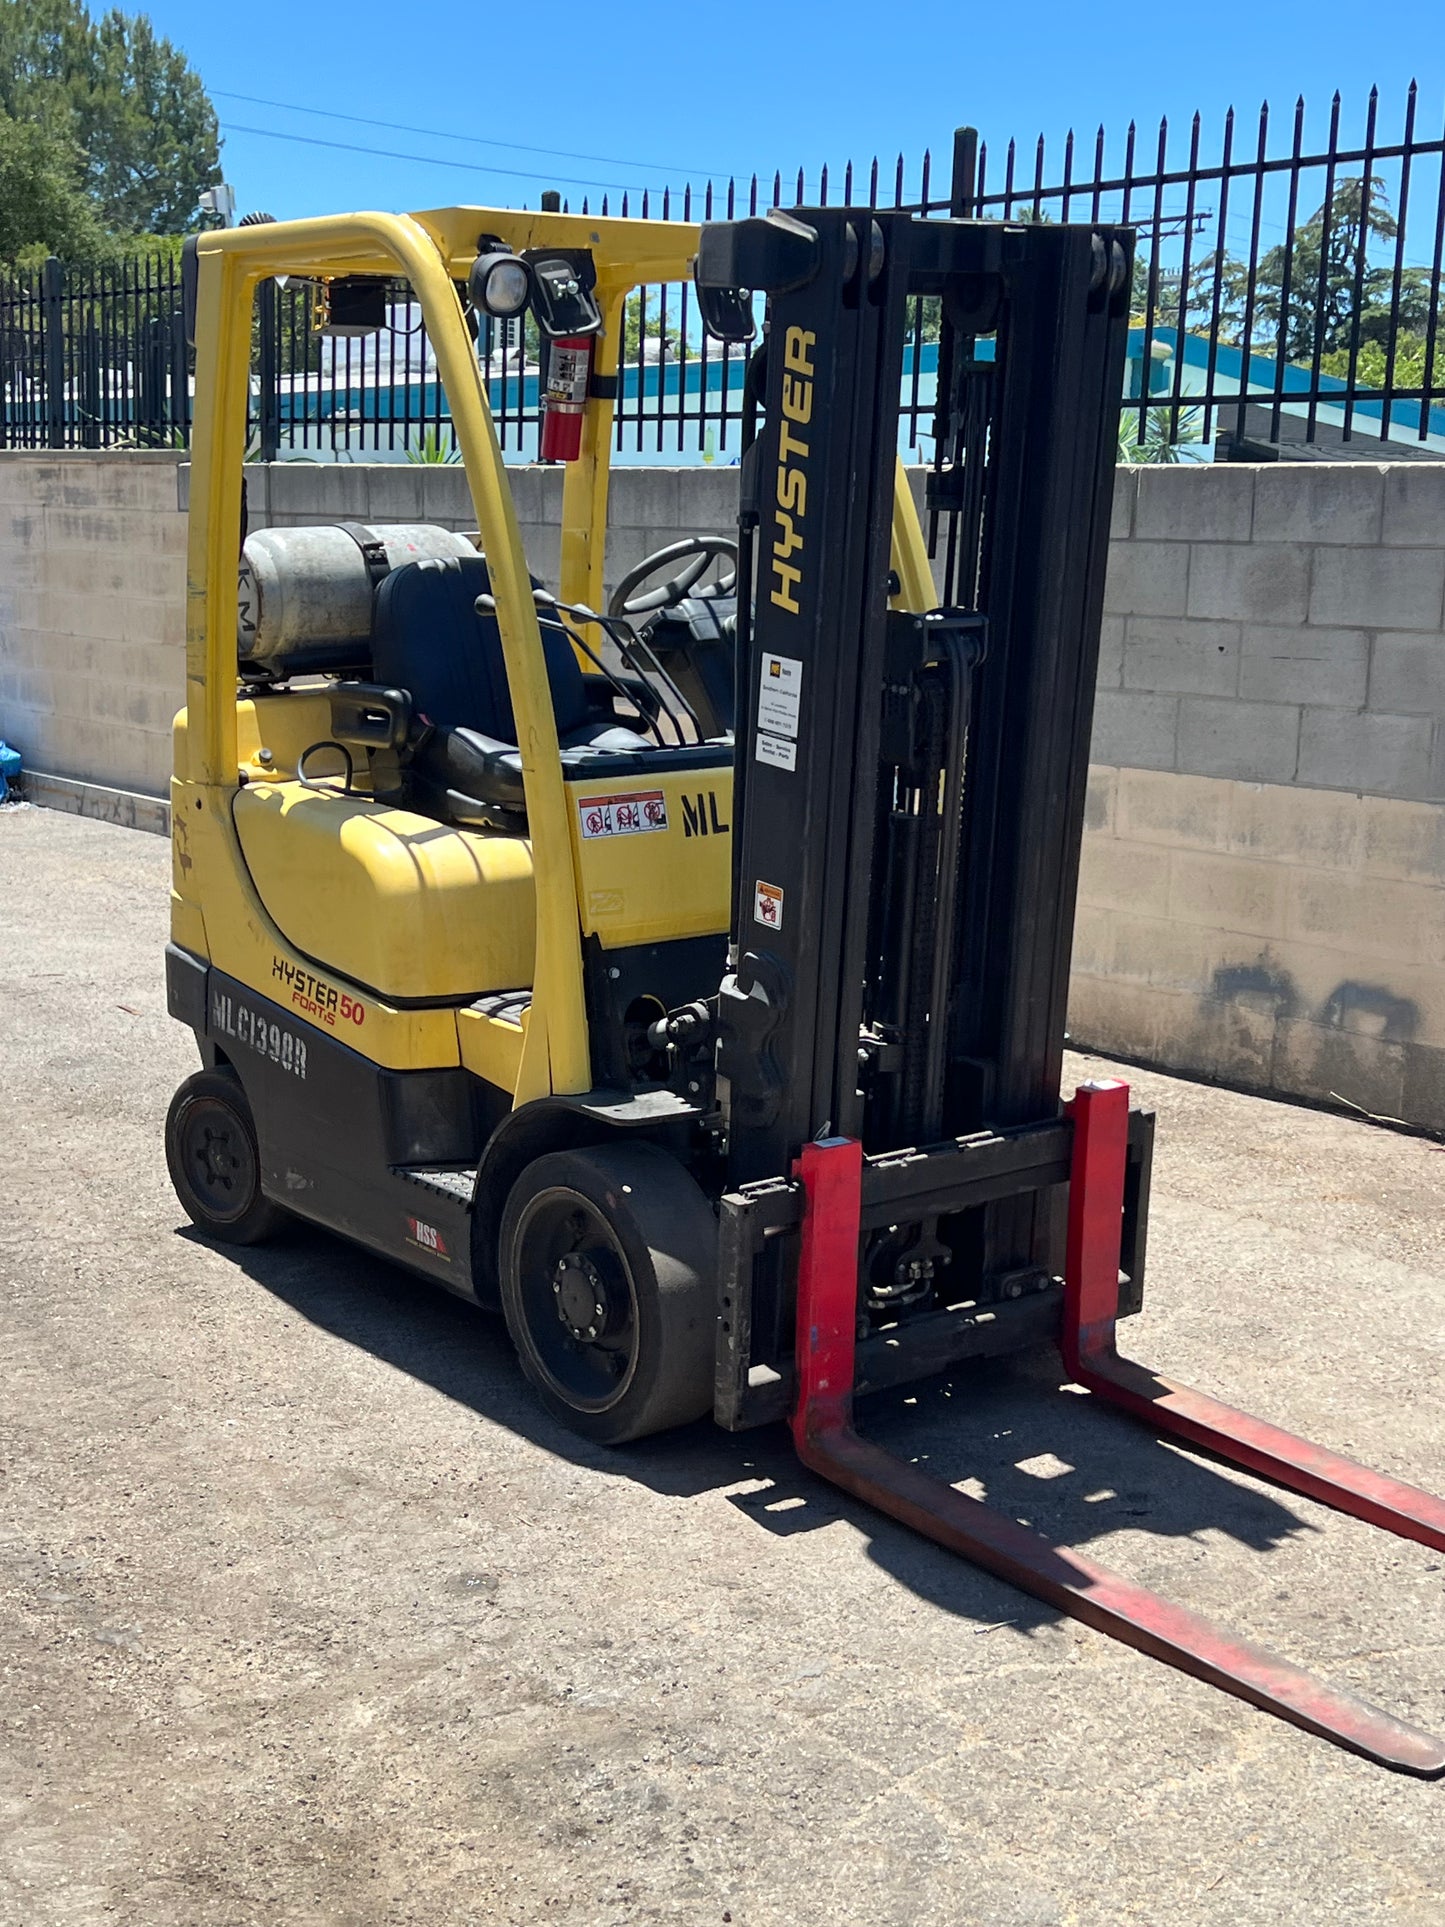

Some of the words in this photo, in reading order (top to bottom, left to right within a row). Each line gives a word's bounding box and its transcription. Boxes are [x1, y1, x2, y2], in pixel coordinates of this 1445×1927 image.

[770, 325, 816, 615] HYSTER
[681, 792, 729, 837] ML
[272, 956, 338, 1012] HYSTER
[340, 994, 365, 1026] 50
[416, 1220, 437, 1249] HSS
